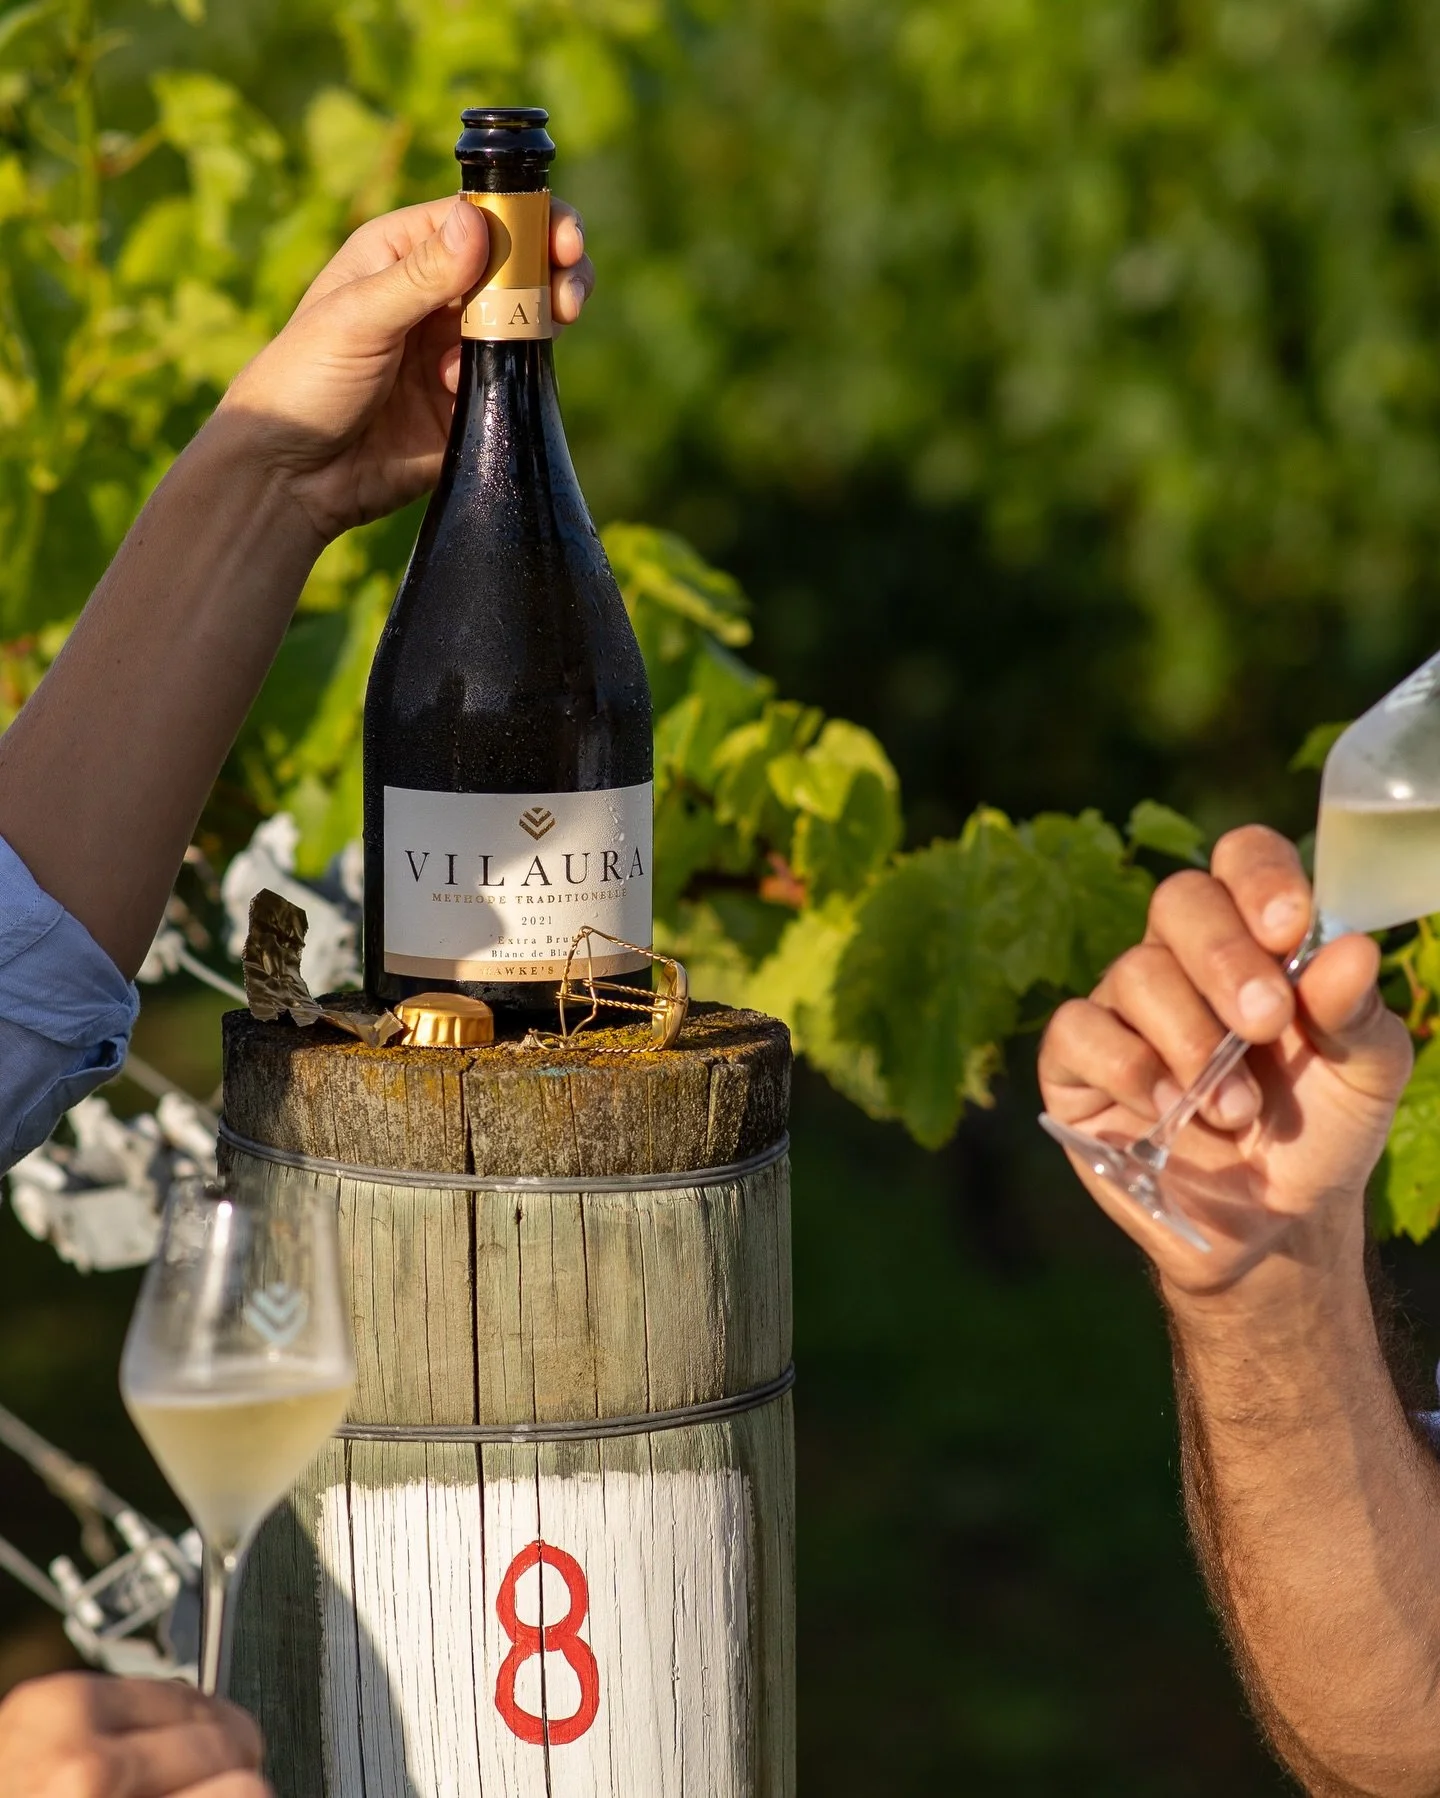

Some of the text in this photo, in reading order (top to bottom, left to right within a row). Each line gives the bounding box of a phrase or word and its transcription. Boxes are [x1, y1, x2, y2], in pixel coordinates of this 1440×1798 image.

[405, 846, 644, 887] VILAURA
[432, 888, 628, 904] METHODE TRADITIONELLE
[521, 916, 552, 926] 2021
[498, 936, 537, 945] Extra
[491, 948, 581, 958] Blanc de Blac
[495, 1539, 600, 1746] 8
